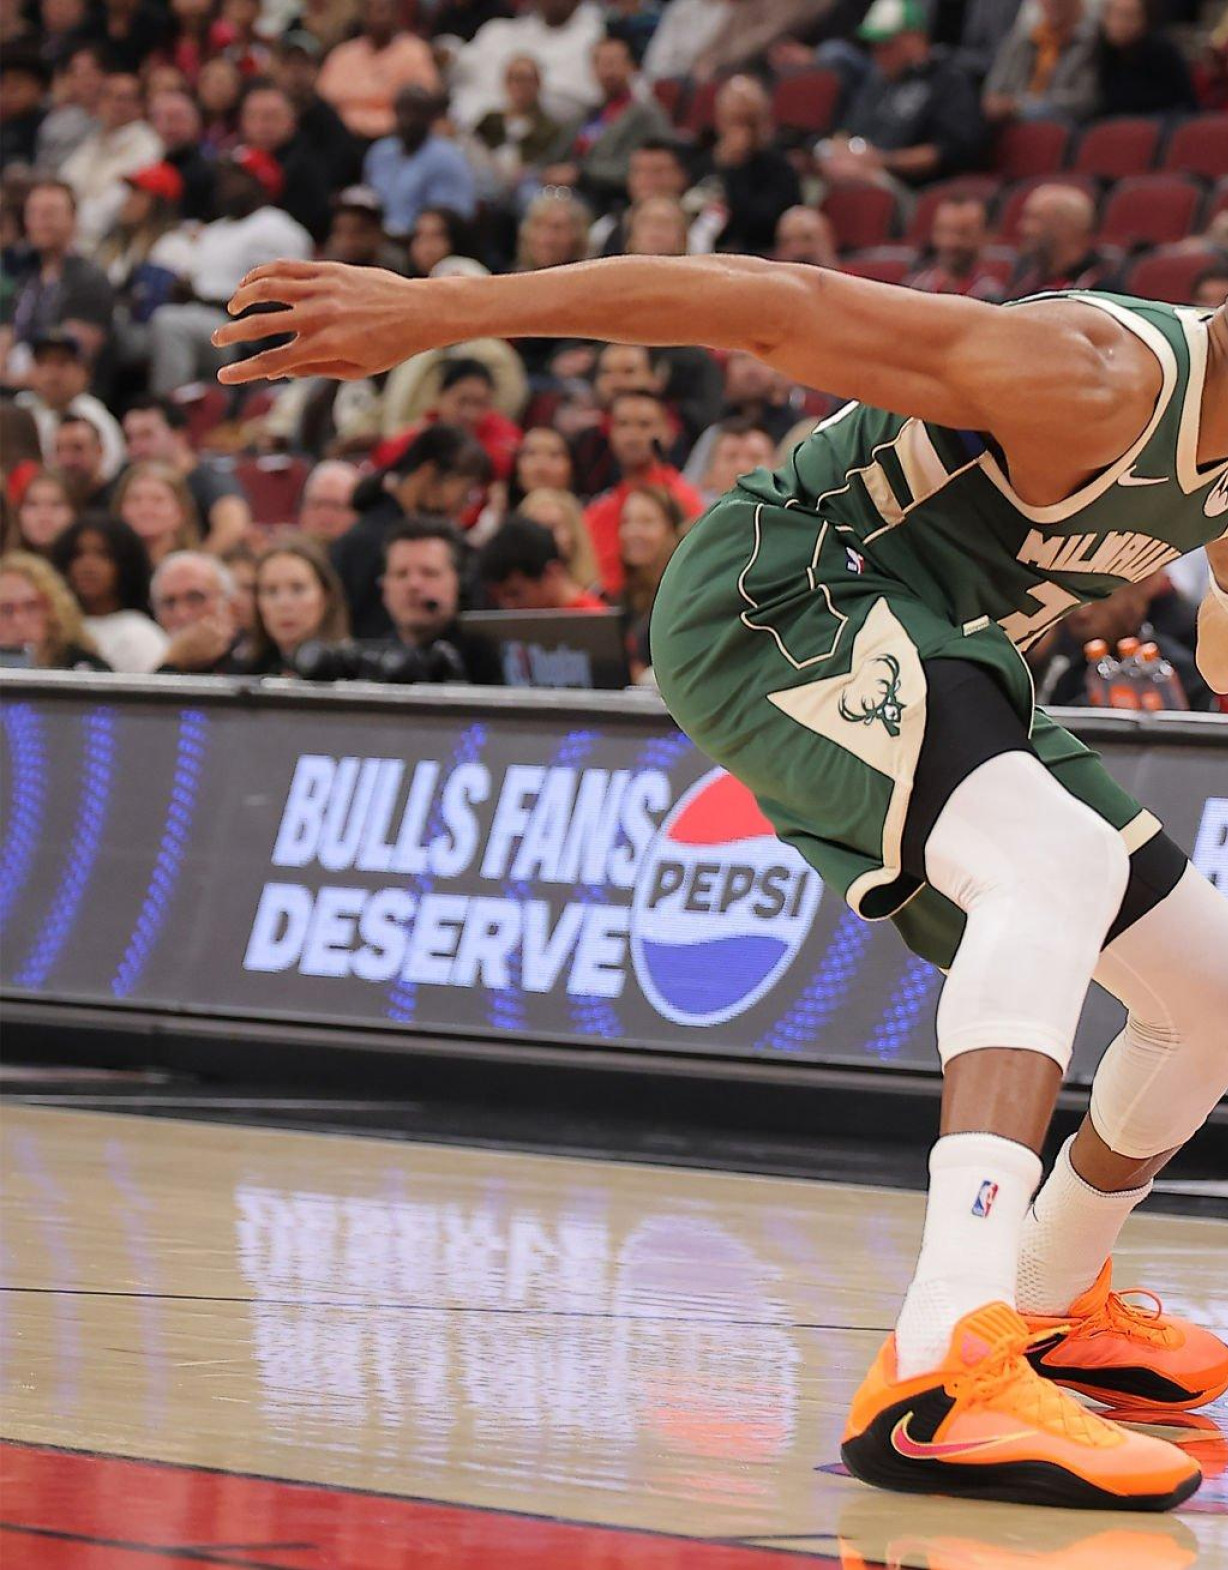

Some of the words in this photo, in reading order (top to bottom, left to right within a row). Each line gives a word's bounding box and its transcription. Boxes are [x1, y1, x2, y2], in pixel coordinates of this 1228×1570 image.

[1016, 528, 1182, 584] MILWAUK
[271, 753, 491, 879] BULLS
[479, 763, 671, 889] FANS
[648, 860, 809, 919] PEPSI
[242, 882, 631, 999] DESERVE
